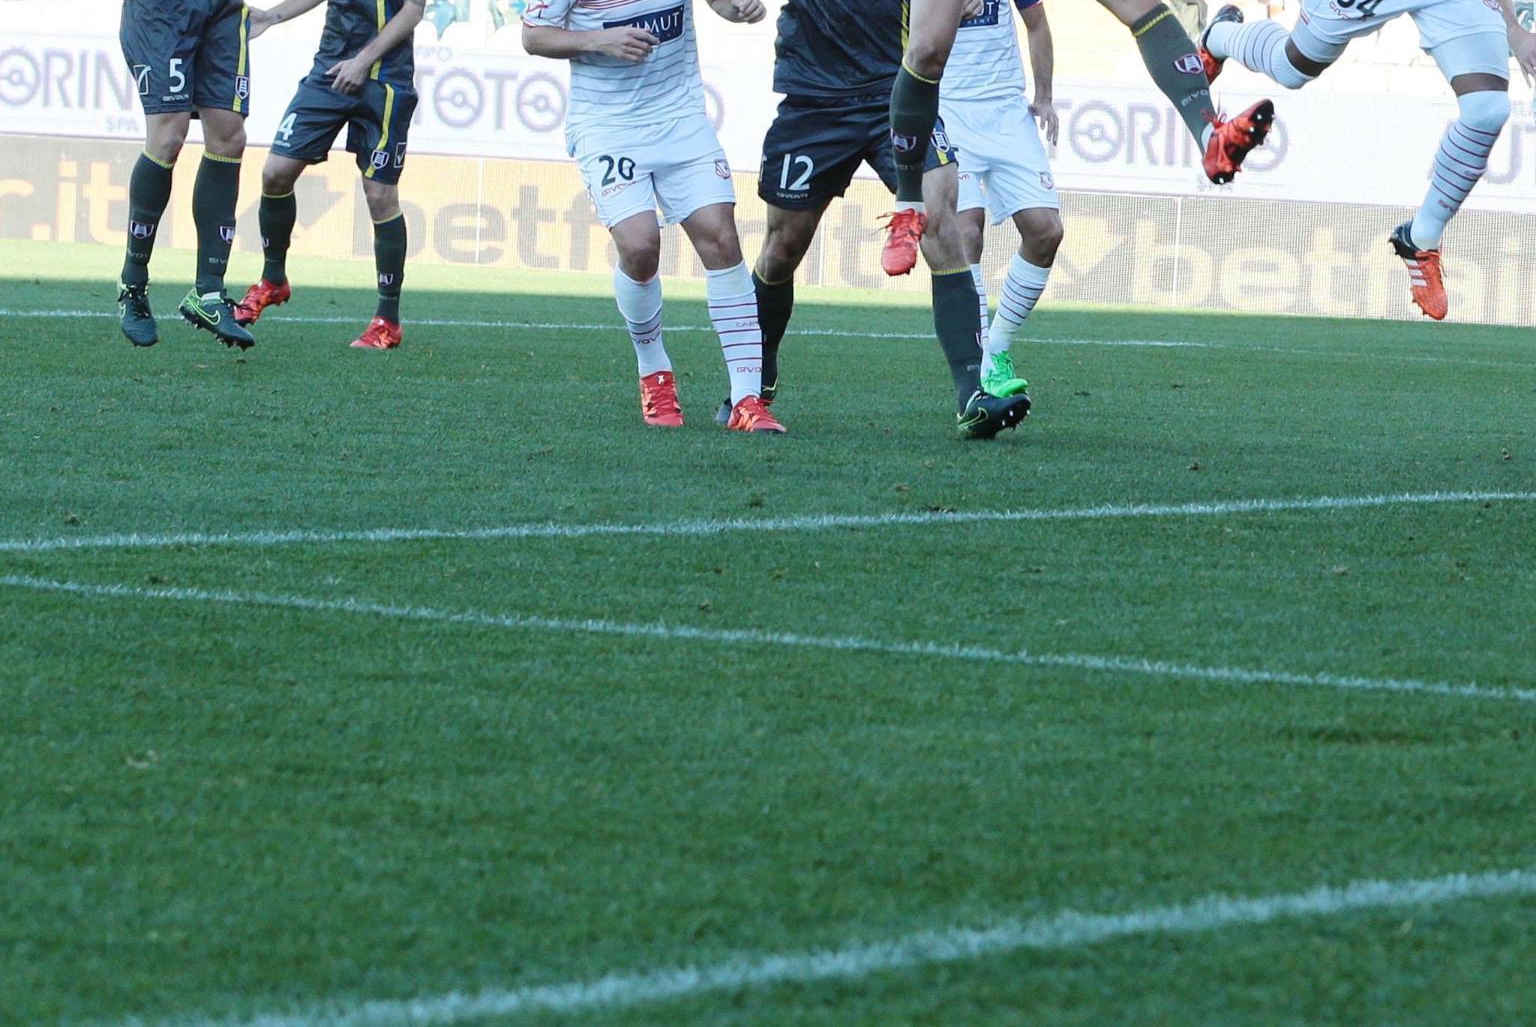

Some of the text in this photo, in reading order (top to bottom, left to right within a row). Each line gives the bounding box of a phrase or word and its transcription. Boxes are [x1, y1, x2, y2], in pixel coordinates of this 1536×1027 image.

[169, 58, 186, 93] 5
[278, 113, 298, 140] 4
[600, 156, 636, 187] 20
[779, 153, 814, 192] 12
